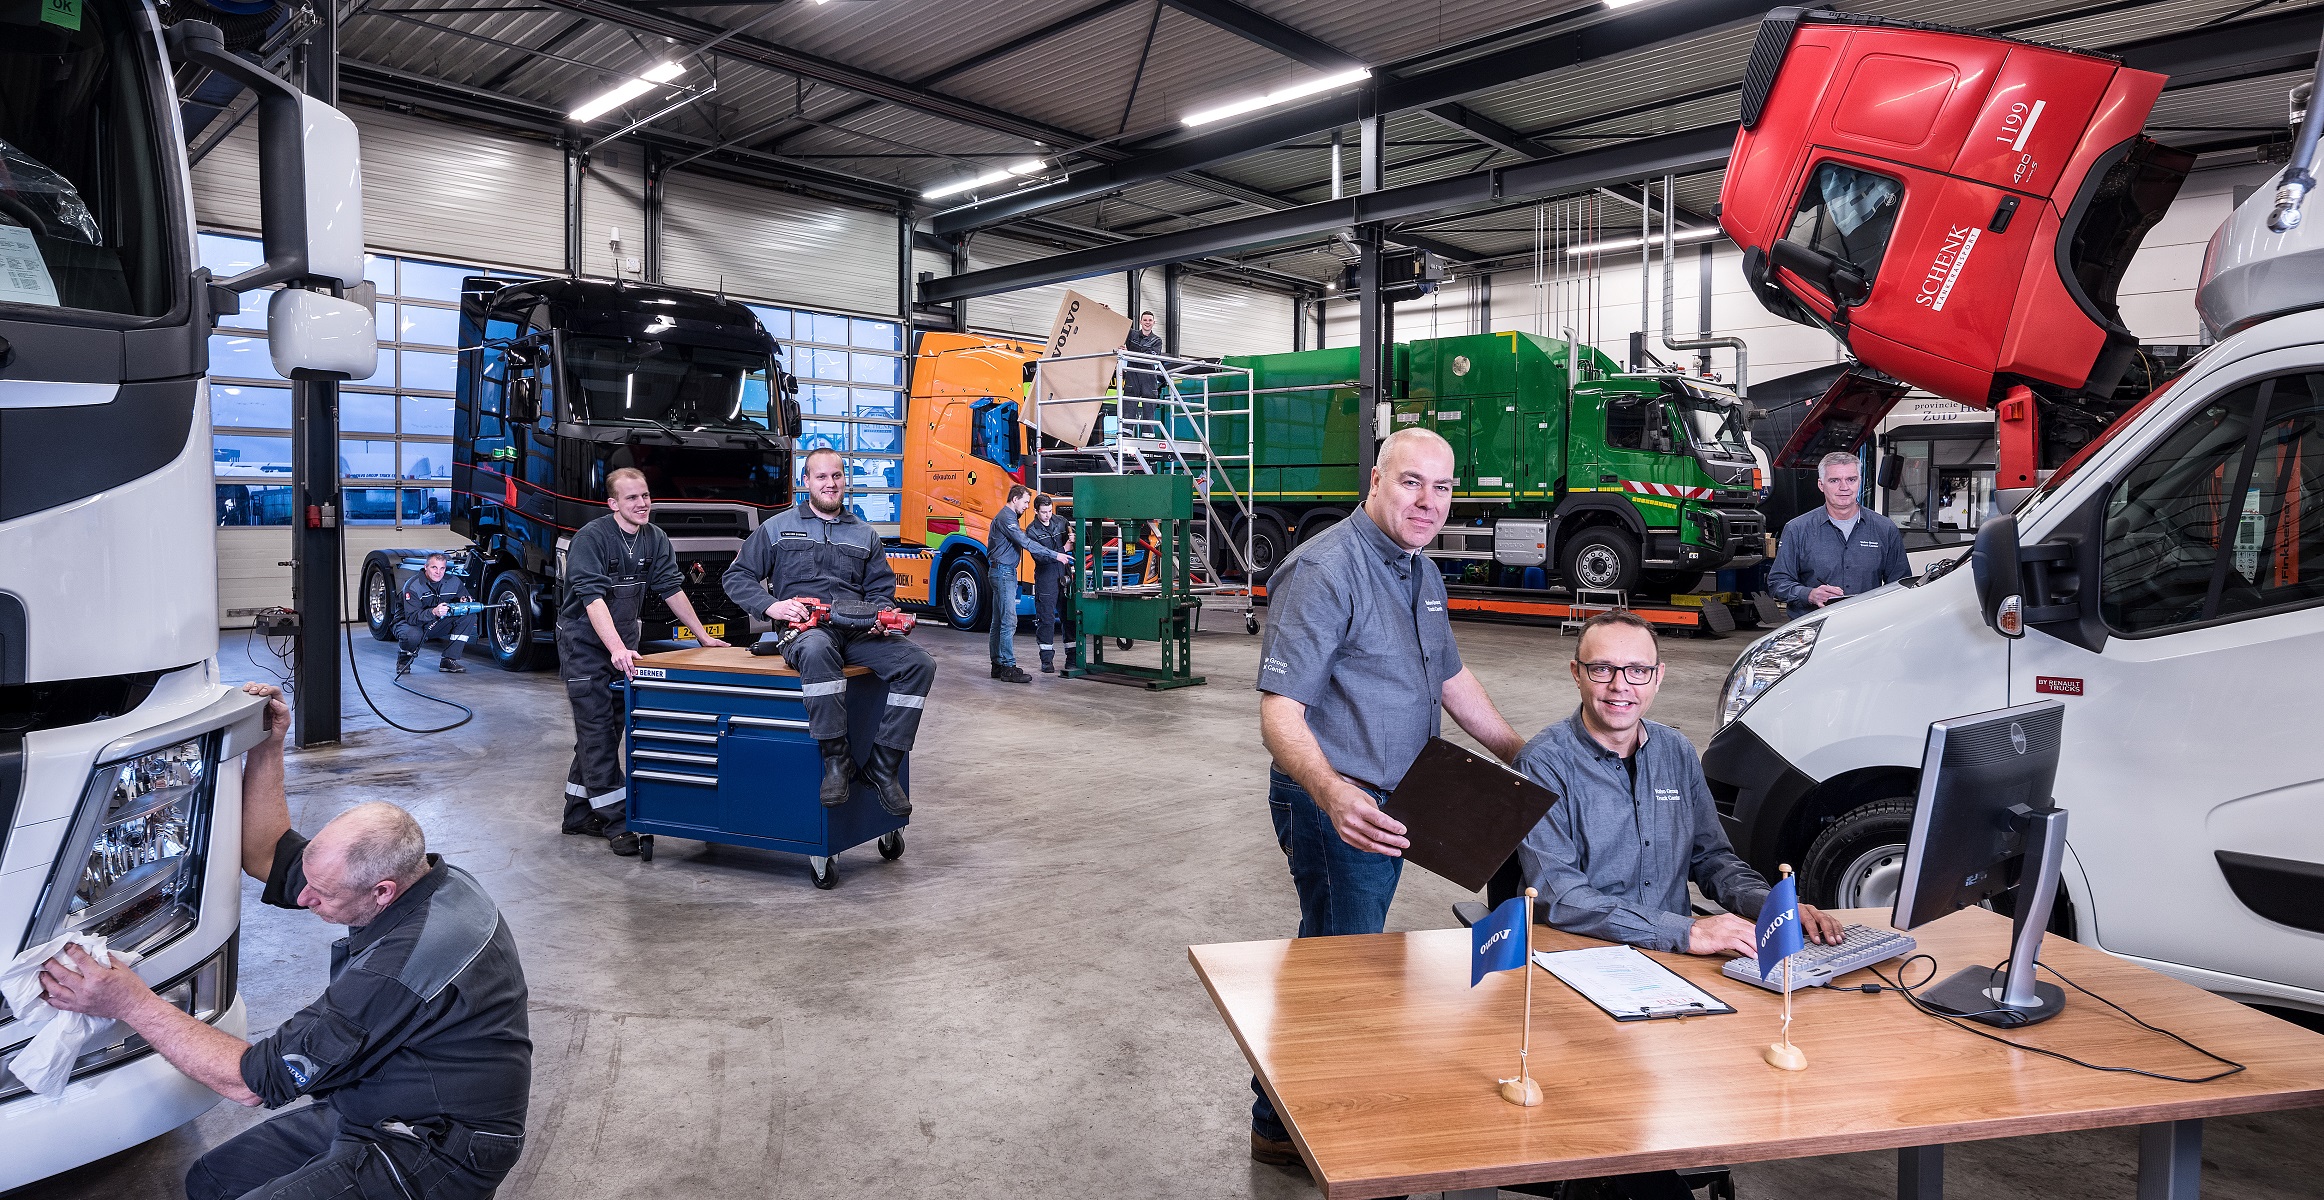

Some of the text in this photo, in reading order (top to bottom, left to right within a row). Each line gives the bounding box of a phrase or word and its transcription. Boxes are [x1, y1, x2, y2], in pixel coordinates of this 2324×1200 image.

[1996, 102, 2028, 145] 1199
[2013, 153, 2032, 184] 400
[1915, 223, 1970, 307] SCHENK
[1936, 233, 1977, 305] TANKTRANSPORT
[1051, 300, 1080, 358] VOLVO
[1914, 401, 1959, 411] provincie
[1267, 664, 1288, 675] Center
[1269, 657, 1288, 669] Group
[639, 669, 664, 678] BERNER
[2048, 680, 2081, 688] RENAULT
[2050, 685, 2081, 693] TRUCKS
[286, 1065, 307, 1083] OLVO
